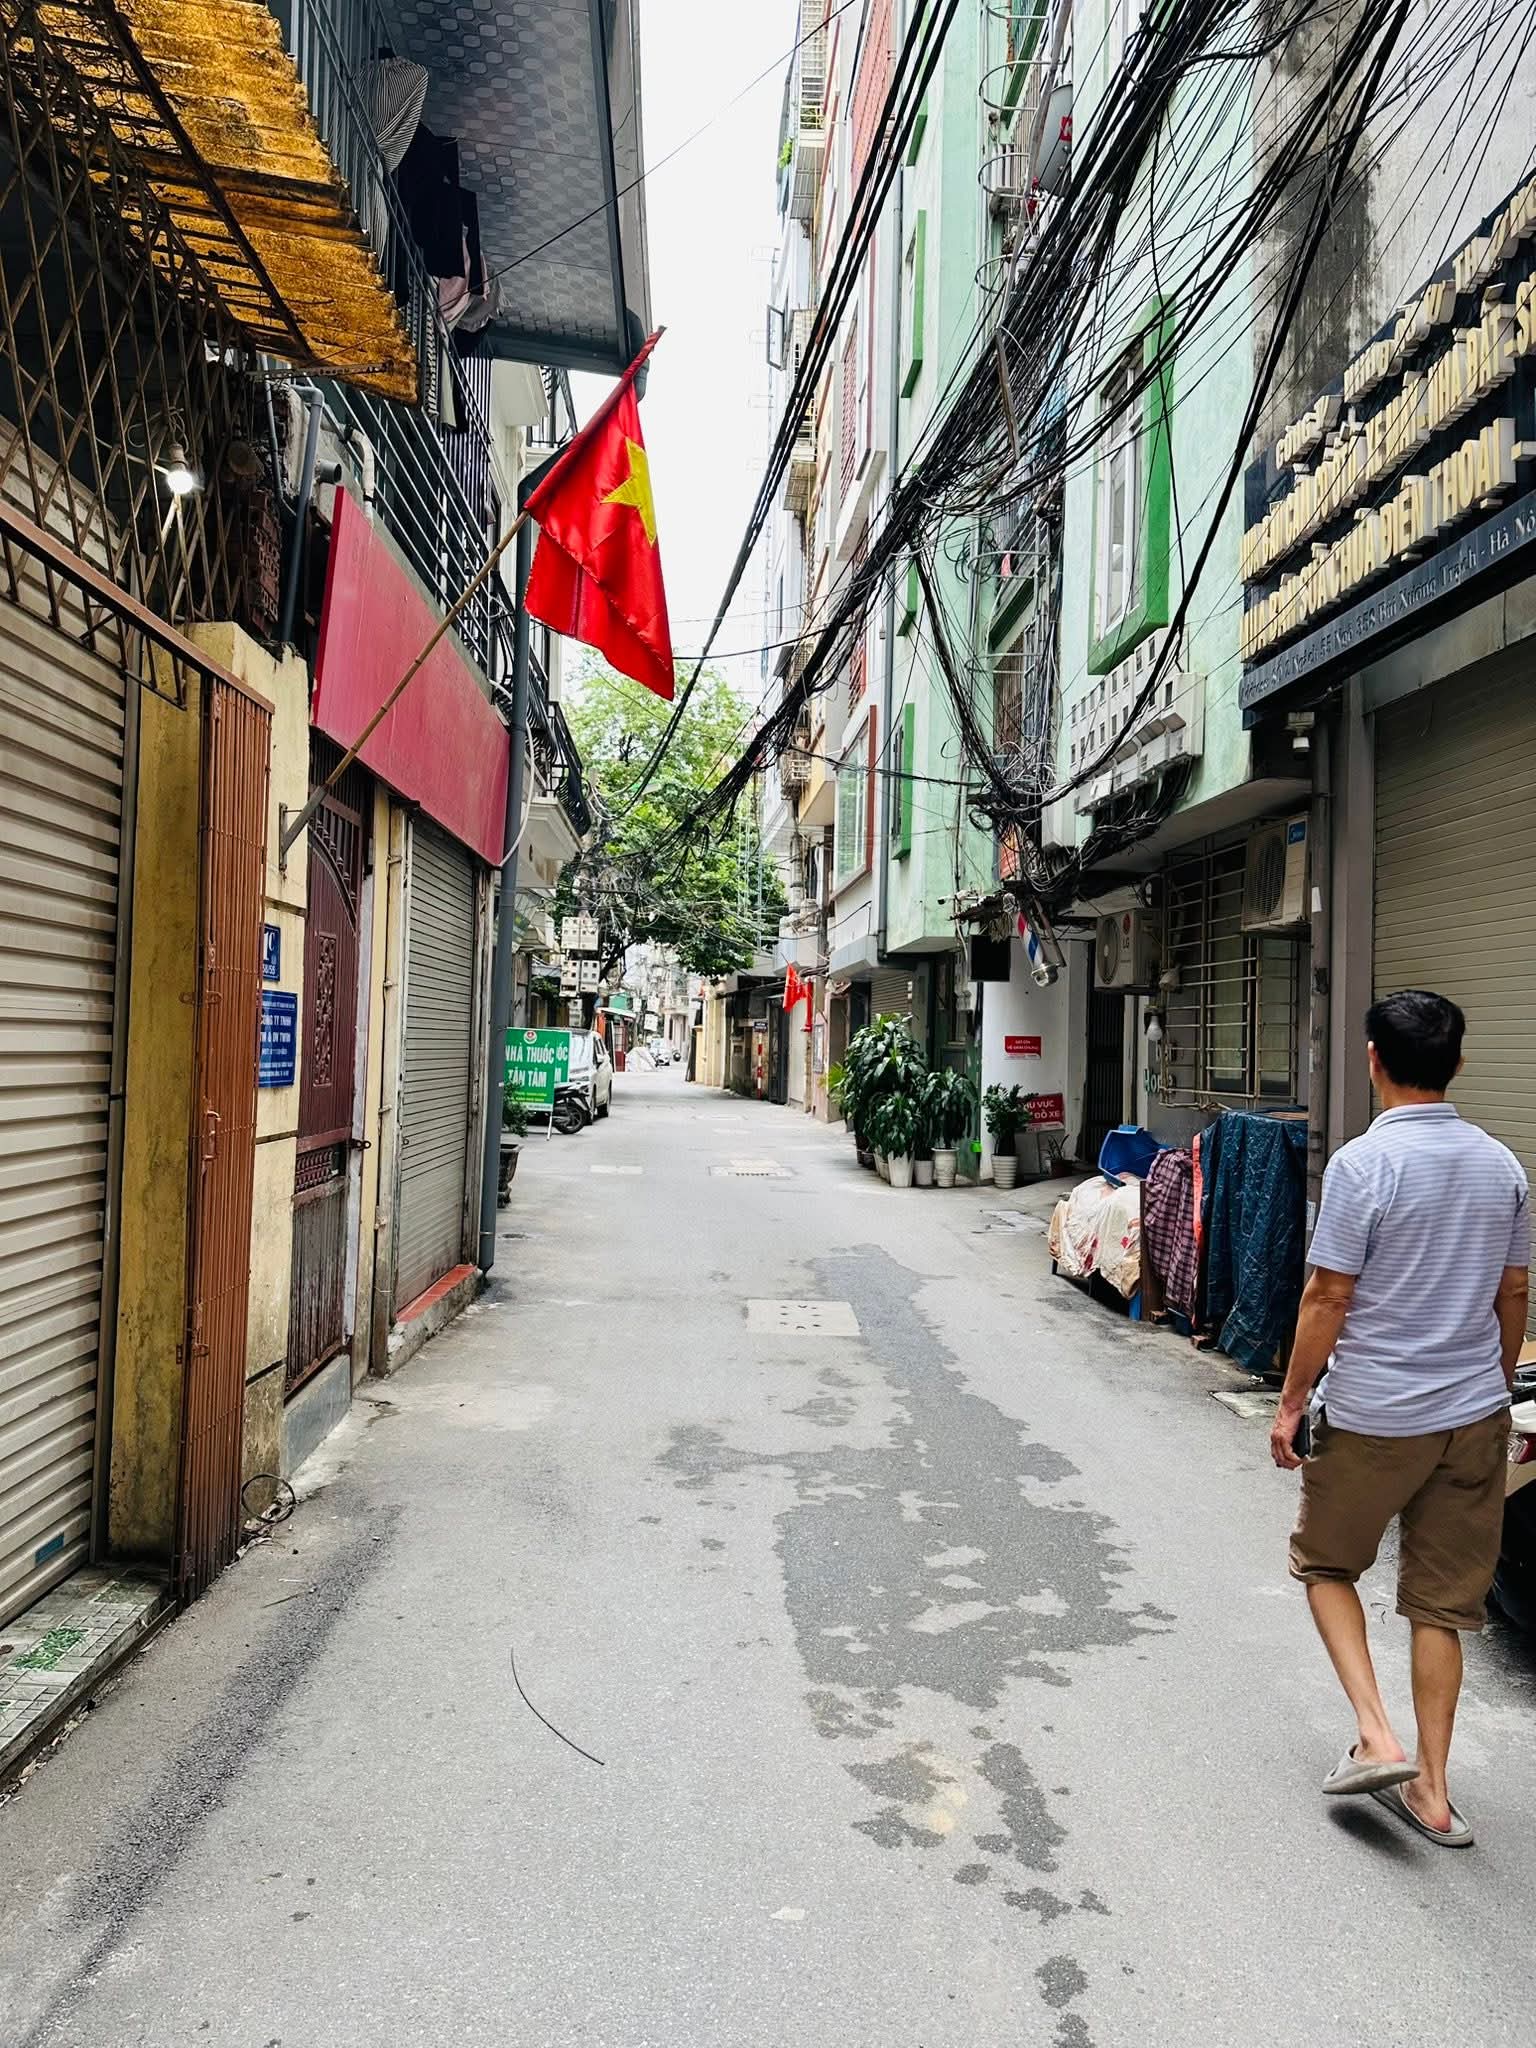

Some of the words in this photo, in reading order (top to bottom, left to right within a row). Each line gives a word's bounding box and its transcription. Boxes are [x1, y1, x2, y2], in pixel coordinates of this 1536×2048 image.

[1269, 573, 1297, 642] BÁN
[1380, 475, 1424, 565] ĐIỆN
[1429, 418, 1501, 529] THOẠI
[1490, 527, 1510, 555] Hà
[526, 1041, 554, 1065] THUỐC
[528, 1067, 547, 1088] TÂM
